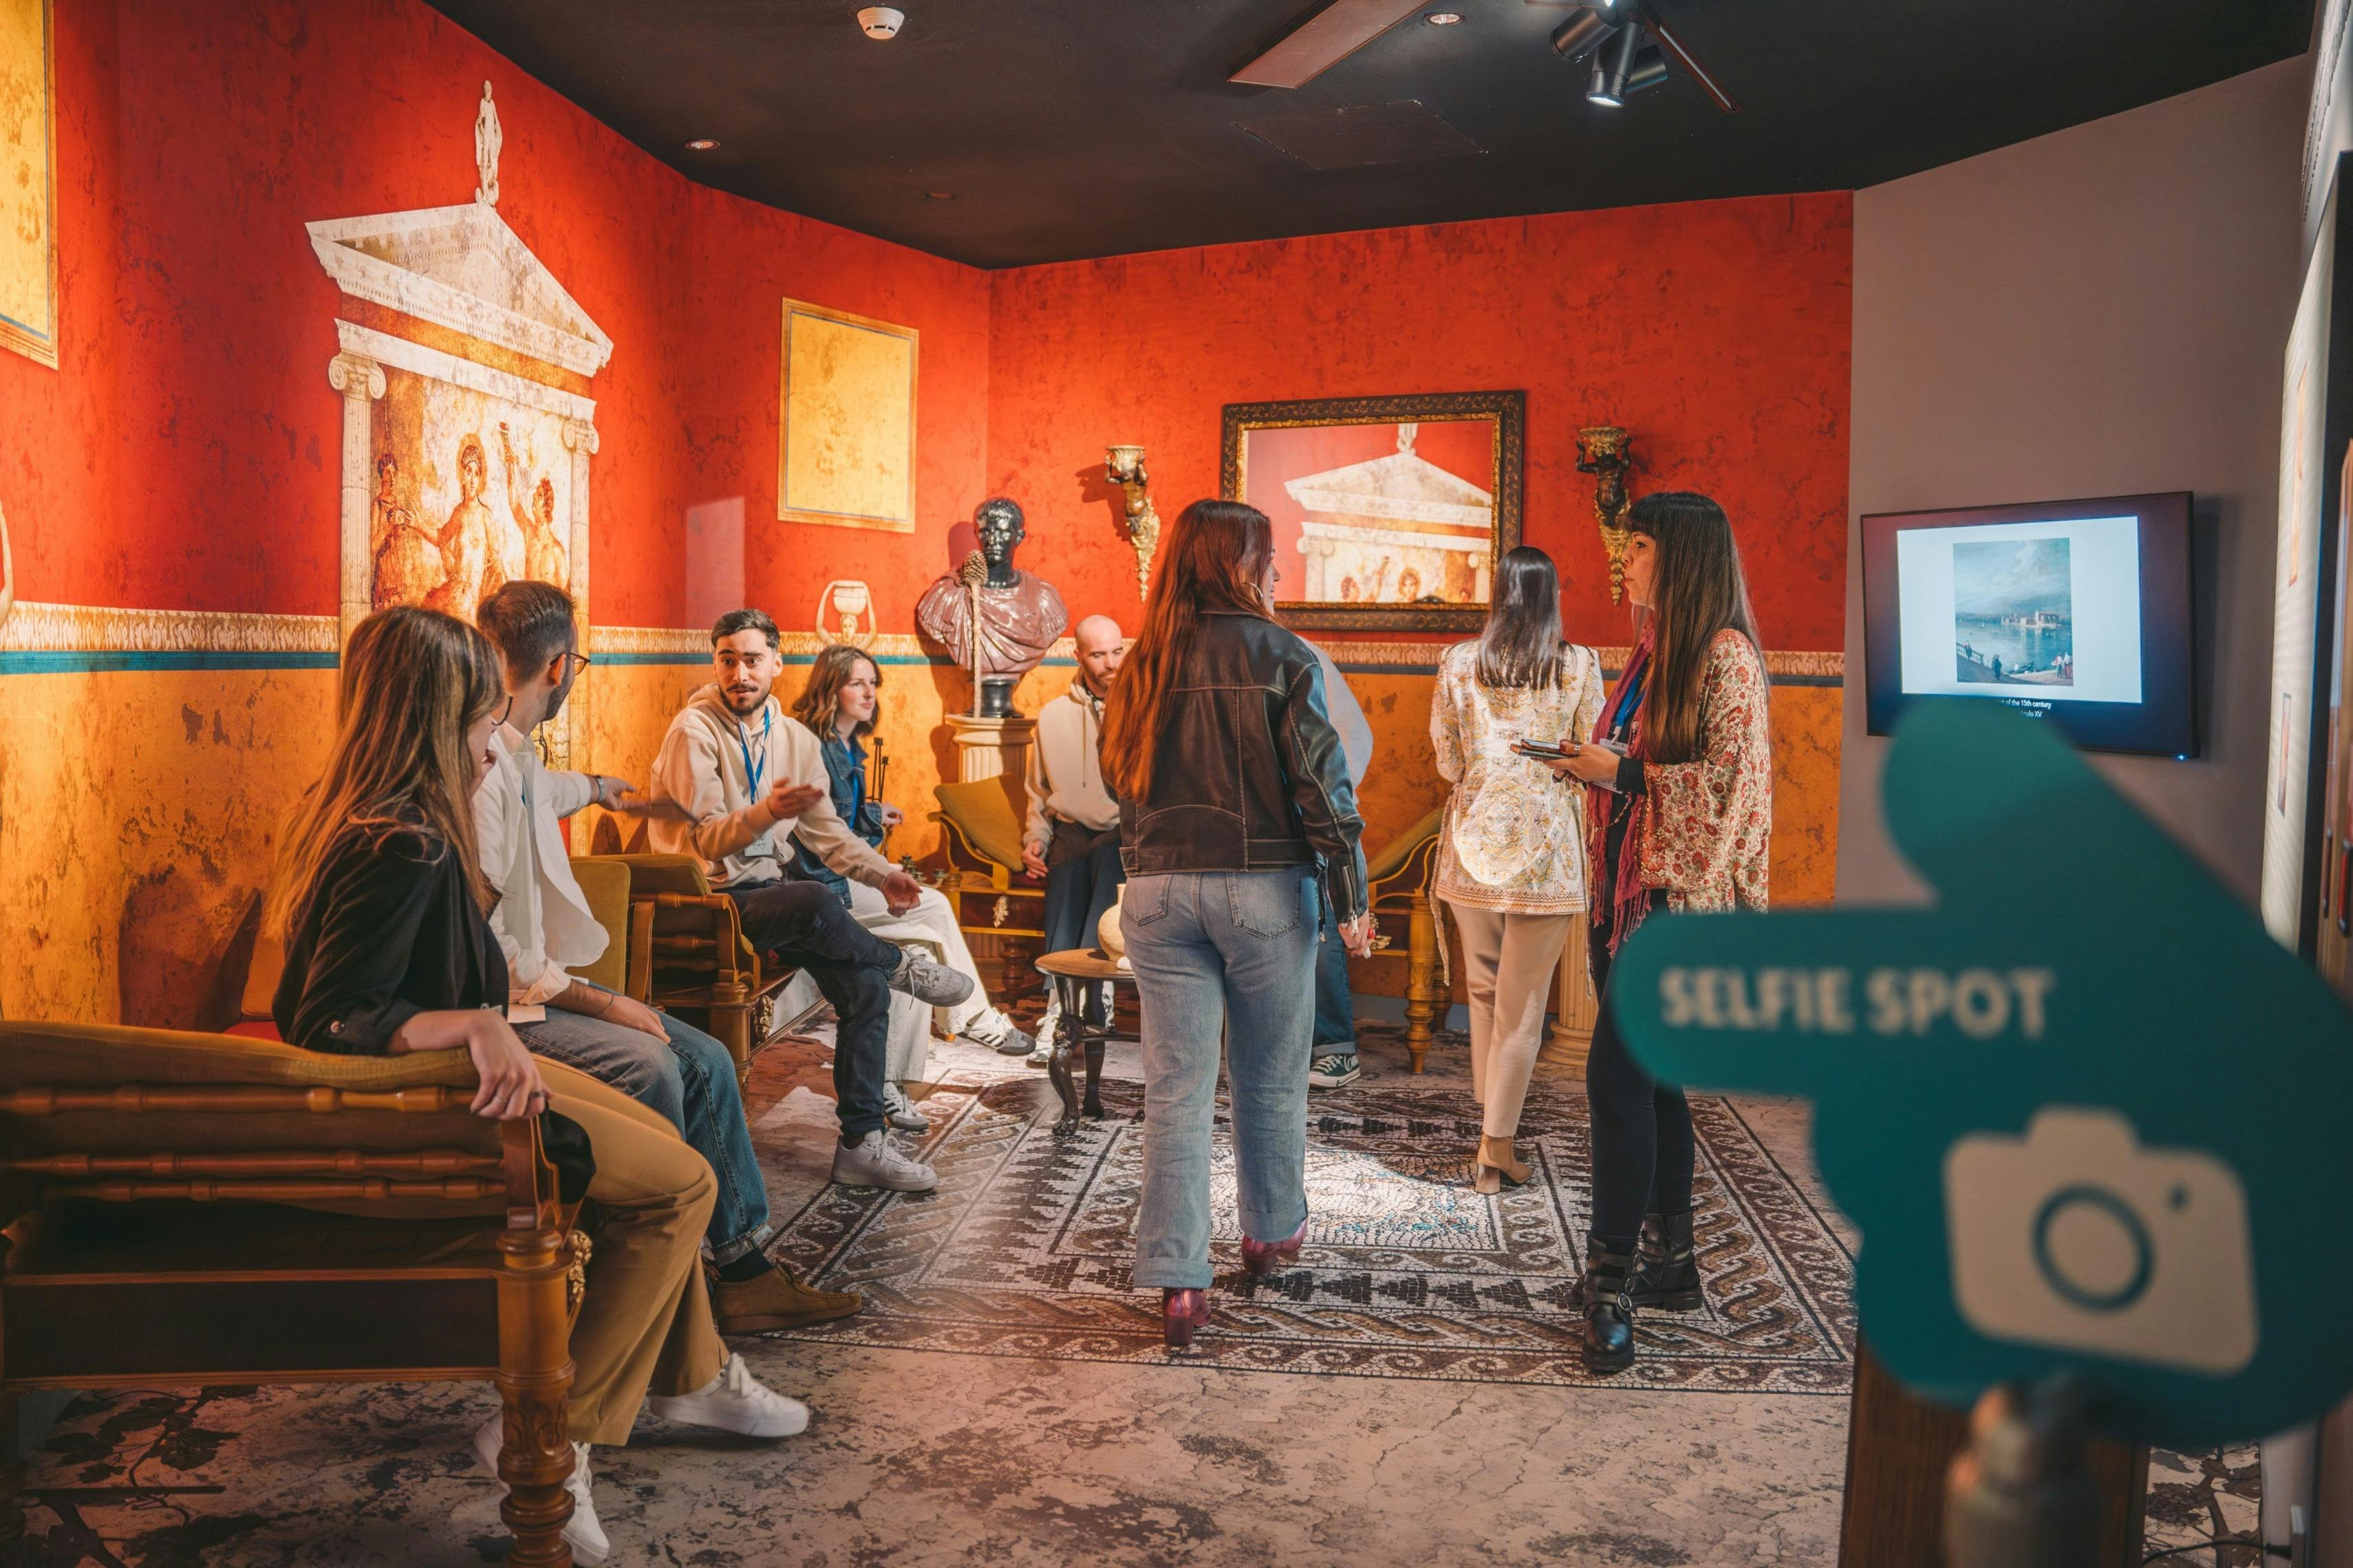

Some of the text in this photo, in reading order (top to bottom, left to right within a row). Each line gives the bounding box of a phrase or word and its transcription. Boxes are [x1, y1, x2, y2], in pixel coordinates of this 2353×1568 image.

[2033, 701, 2052, 709] century
[1659, 967, 2052, 1040] SELFIE SPOT
